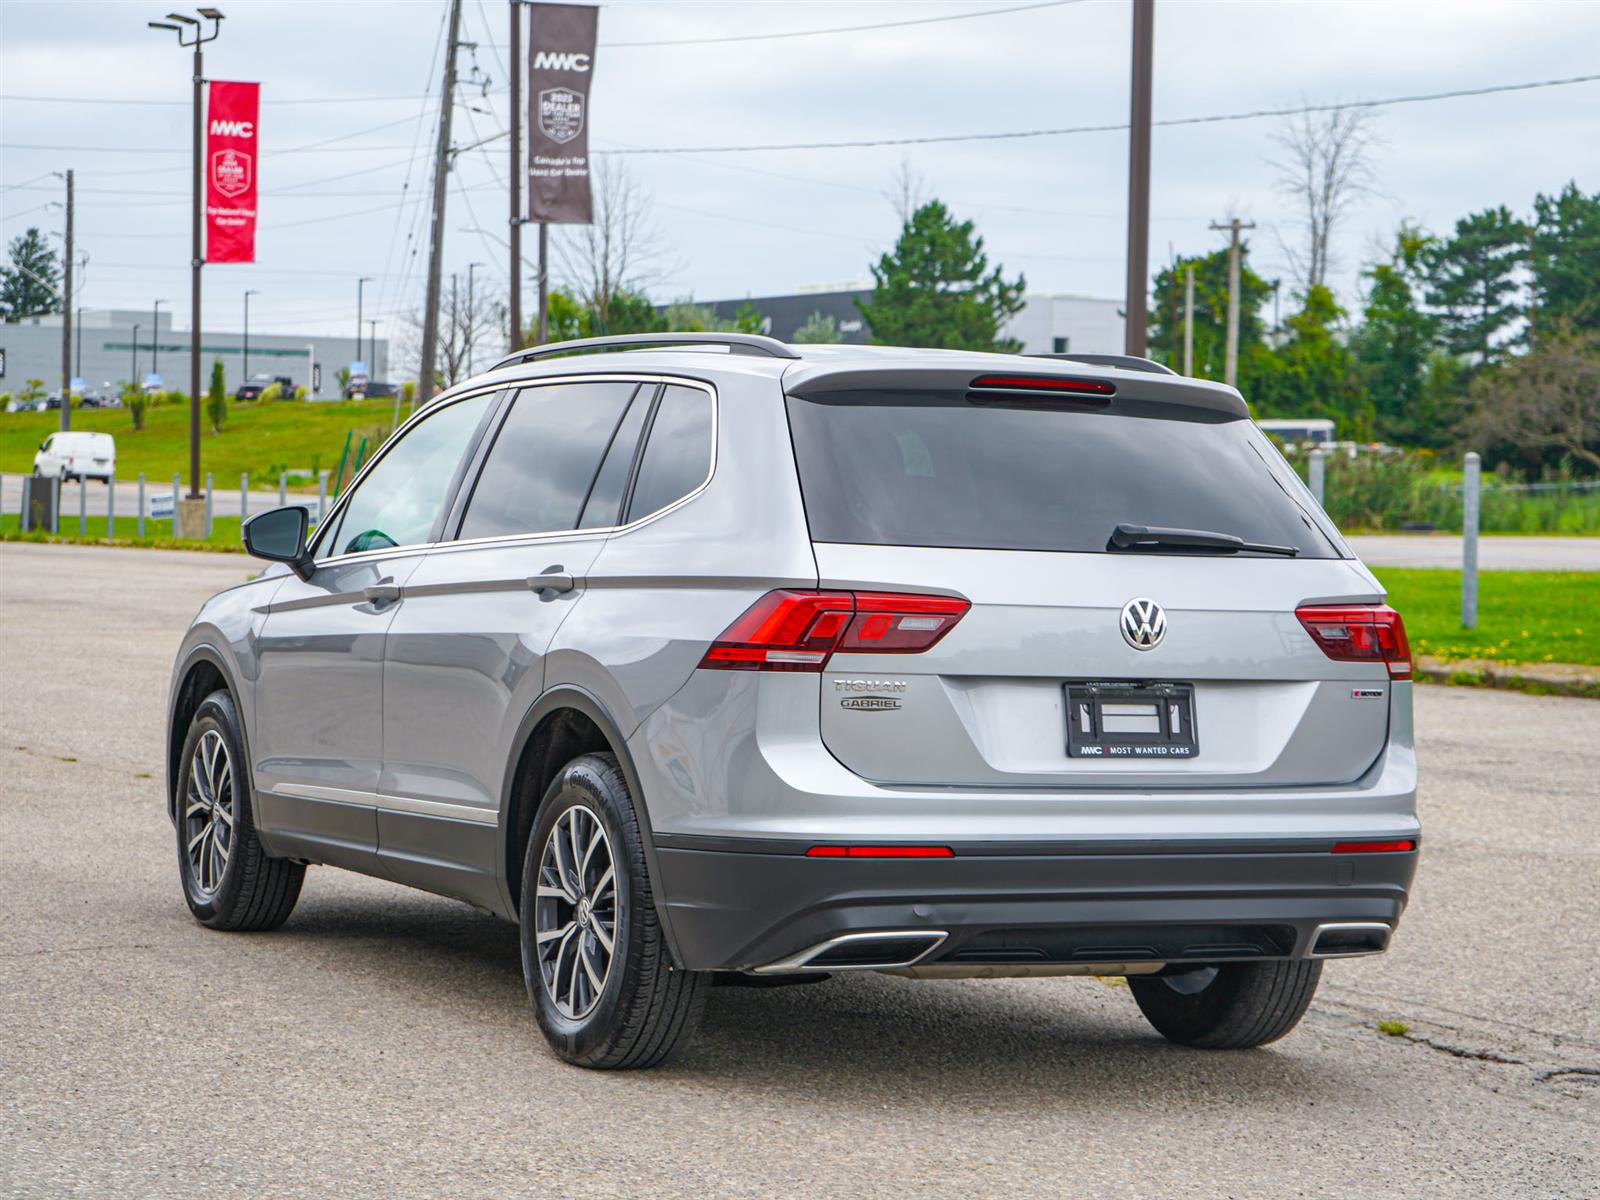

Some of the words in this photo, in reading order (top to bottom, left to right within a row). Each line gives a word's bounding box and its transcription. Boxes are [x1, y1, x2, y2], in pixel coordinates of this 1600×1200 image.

[534, 51, 590, 72] MWC
[543, 101, 581, 112] DEALER
[210, 119, 254, 139] MWC
[833, 679, 907, 692] TIGUAN
[840, 699, 902, 708] GABRIEL
[1081, 746, 1103, 755] MWC
[1110, 746, 1132, 755] MOST
[1134, 746, 1167, 755] WANTED
[1170, 747, 1190, 755] CARS
